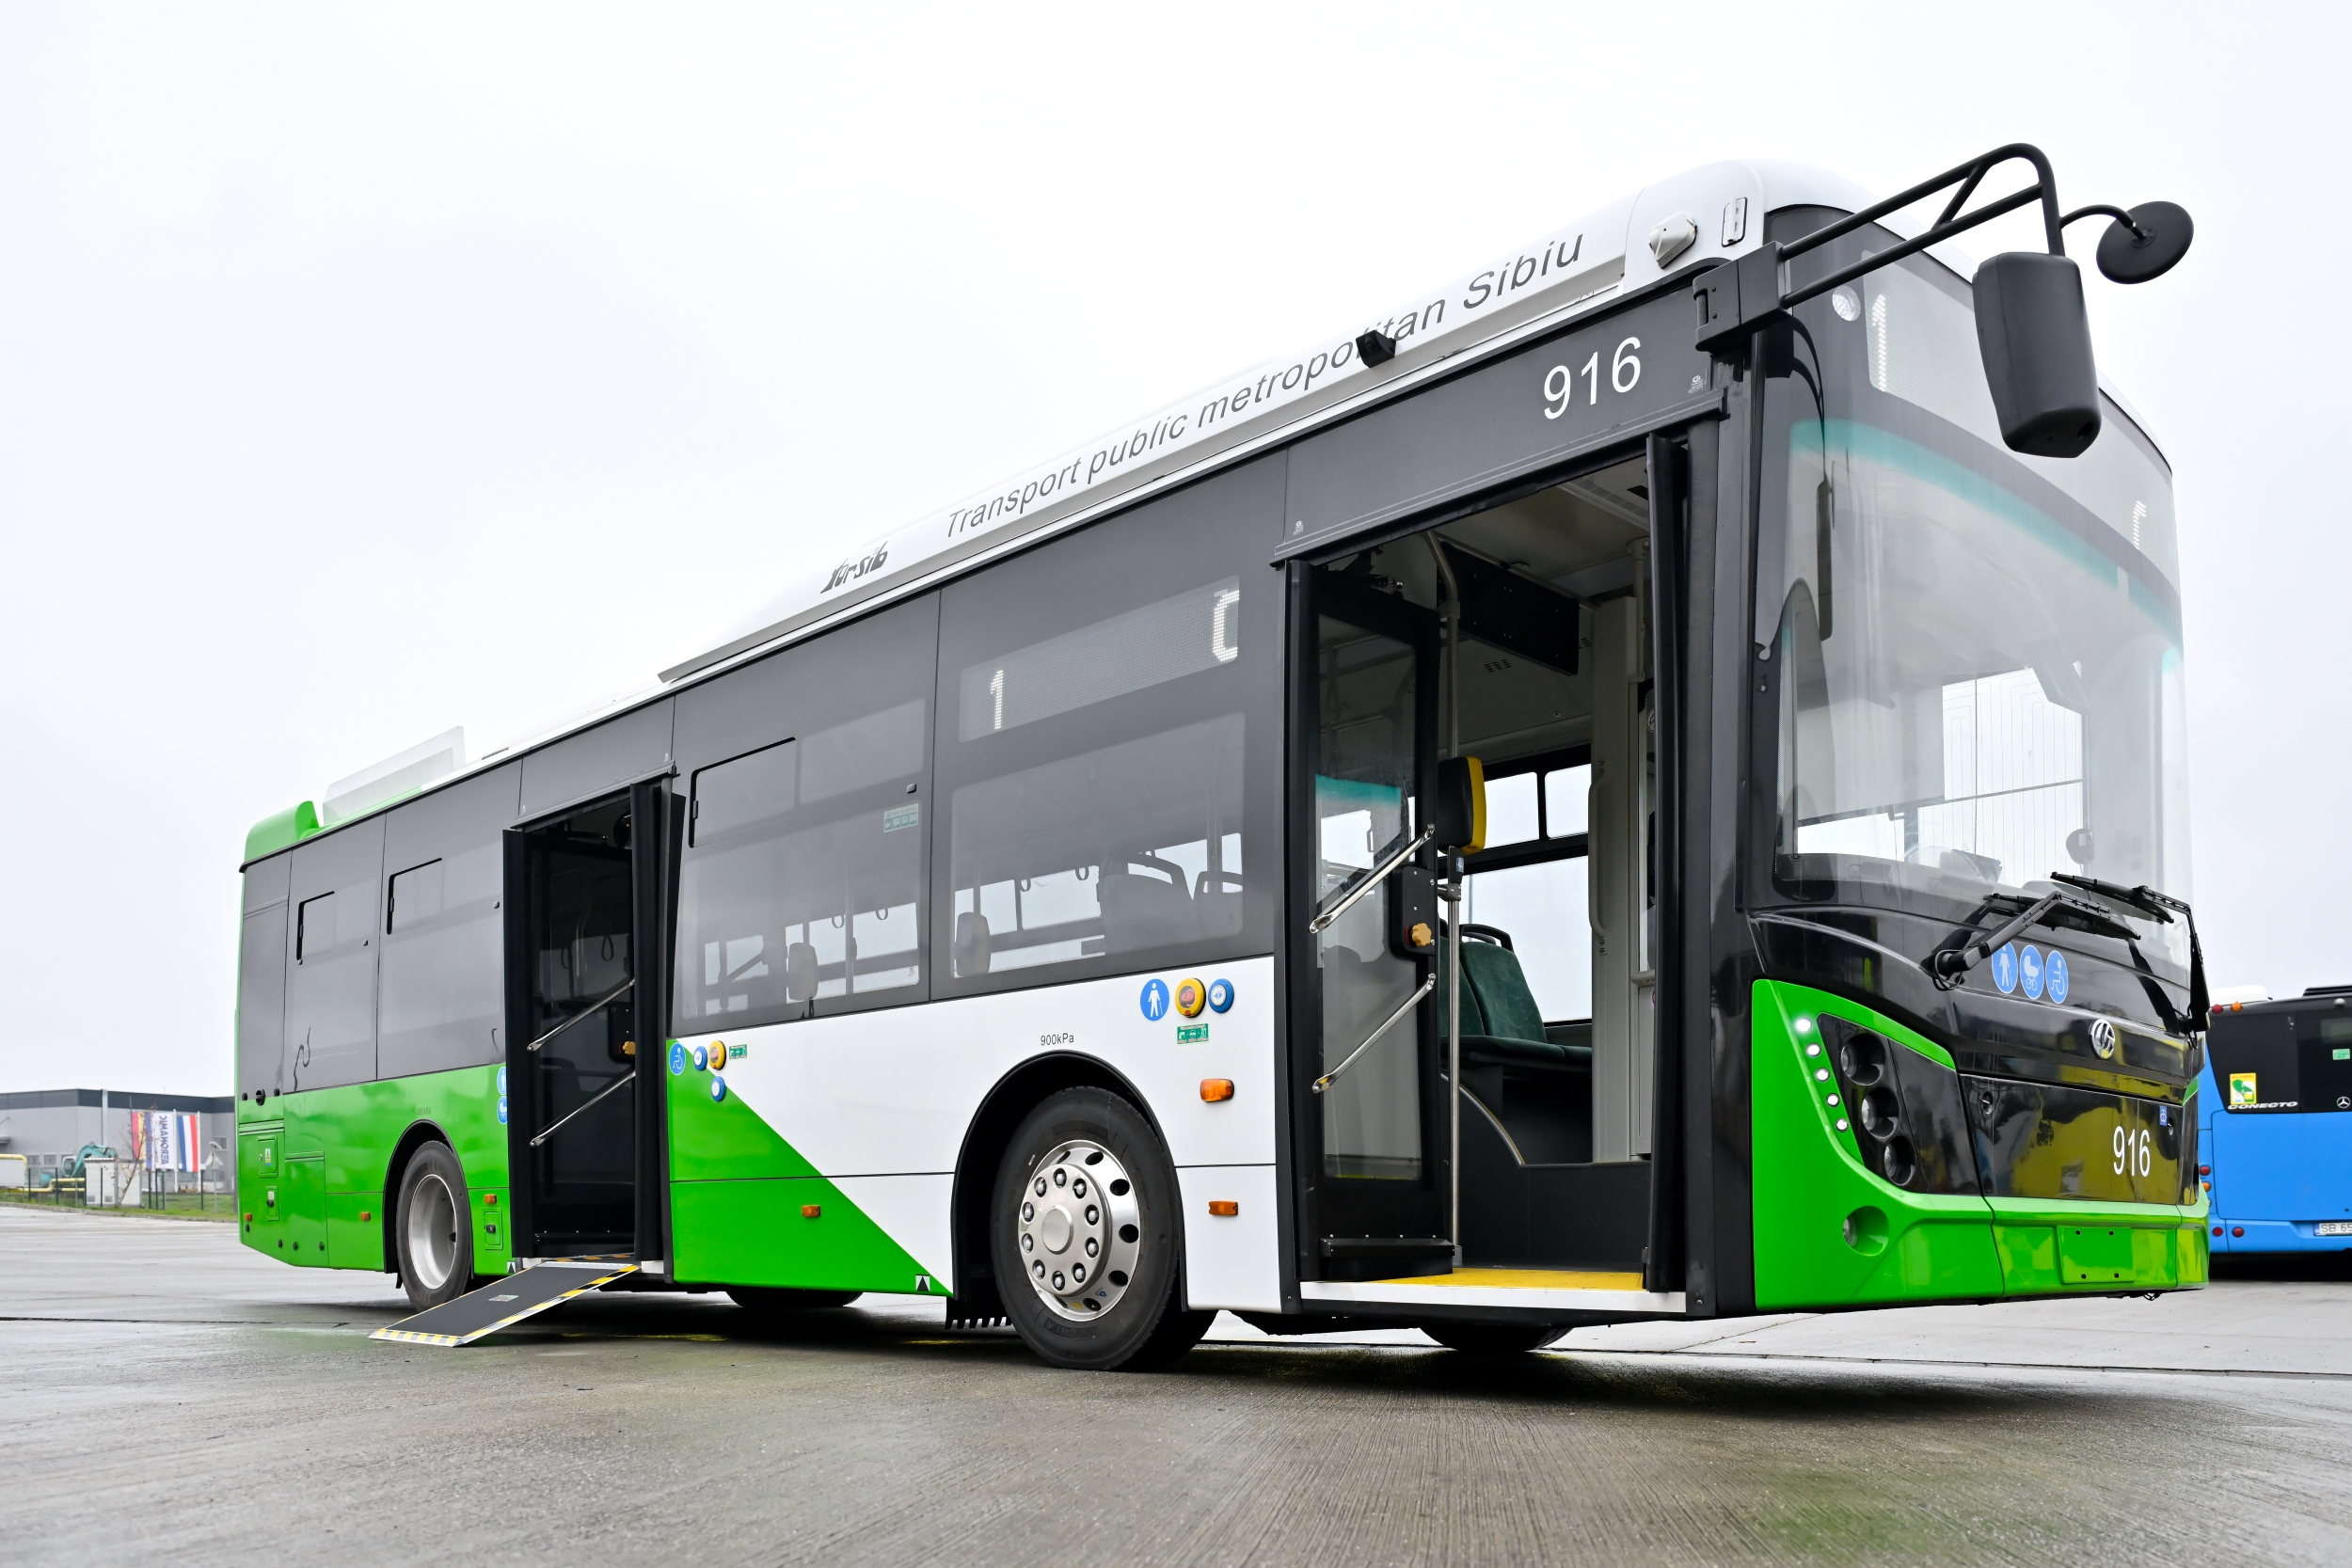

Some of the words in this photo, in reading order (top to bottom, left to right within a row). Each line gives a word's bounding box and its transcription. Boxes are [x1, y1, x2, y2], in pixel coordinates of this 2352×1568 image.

[1871, 293, 1886, 392] 1
[947, 456, 1082, 538] Transport
[1087, 415, 1188, 485] public
[1198, 298, 1446, 429] metropotan
[1463, 233, 1583, 309] Sibiu
[1544, 336, 1642, 420] 916
[991, 670, 1004, 730] 1
[1041, 1032, 1074, 1046] 900kPa
[2227, 1101, 2298, 1110] CONECTO
[2113, 1125, 2151, 1177] 916
[2320, 1224, 2337, 1233] SB
